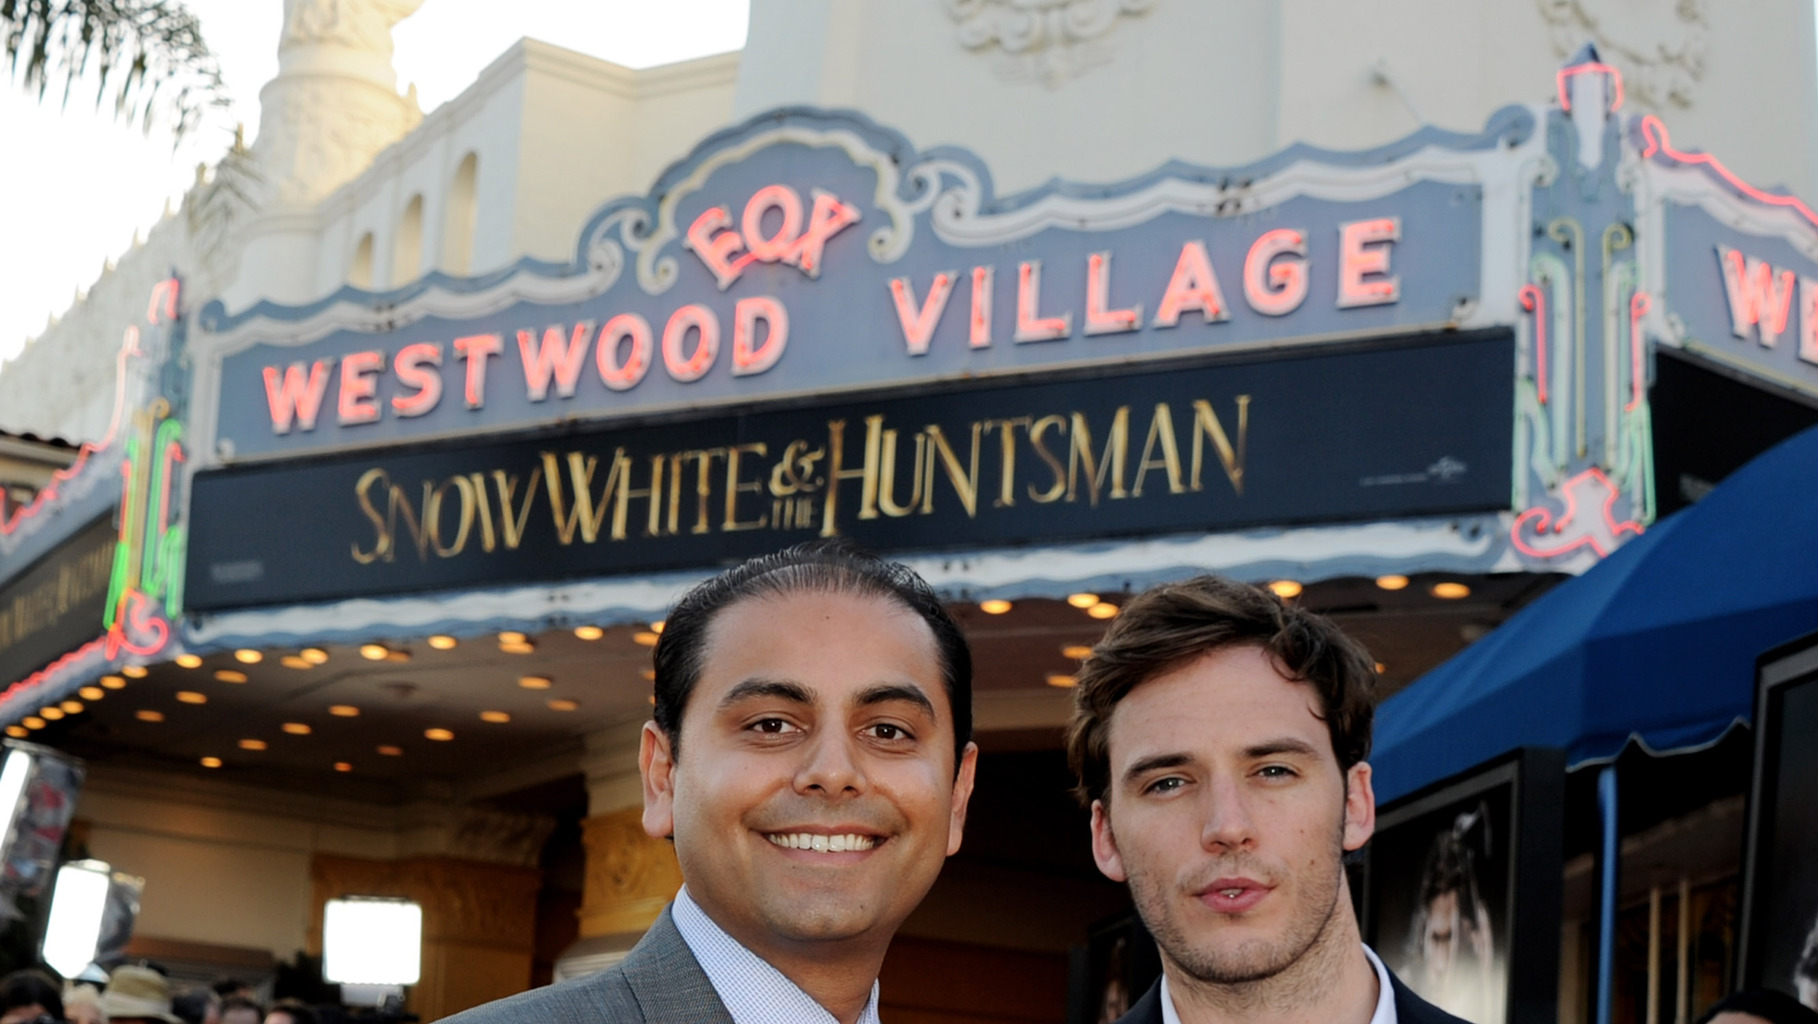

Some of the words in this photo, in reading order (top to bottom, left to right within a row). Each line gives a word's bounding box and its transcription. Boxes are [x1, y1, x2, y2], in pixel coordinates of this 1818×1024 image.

[262, 296, 790, 435] WESTWOOD
[889, 216, 1401, 356] VILLAGE
[351, 464, 543, 565] SNOW
[540, 442, 767, 544] WHITE
[769, 440, 826, 498] &
[819, 393, 1252, 538] HUNTSMAN
